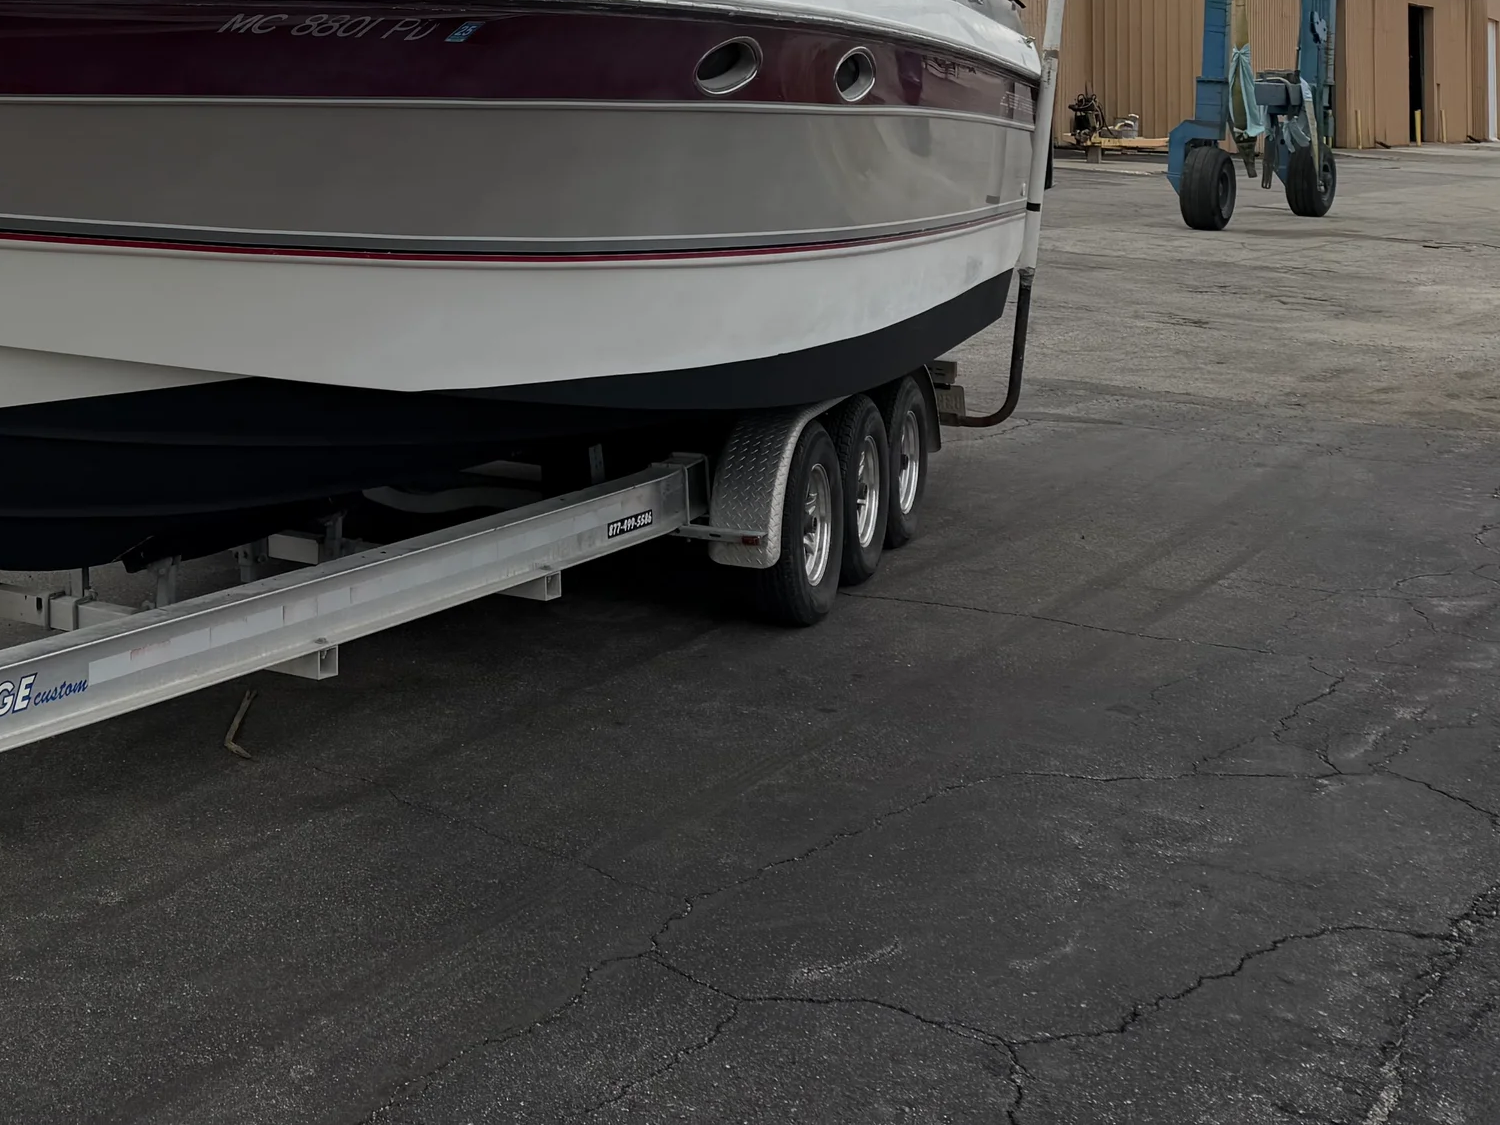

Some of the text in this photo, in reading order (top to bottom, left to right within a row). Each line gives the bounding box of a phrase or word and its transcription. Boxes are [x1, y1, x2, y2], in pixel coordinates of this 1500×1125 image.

[217, 13, 288, 34] MC
[290, 14, 385, 39] 8801
[453, 25, 479, 37] 25
[34, 679, 88, 707] custom
